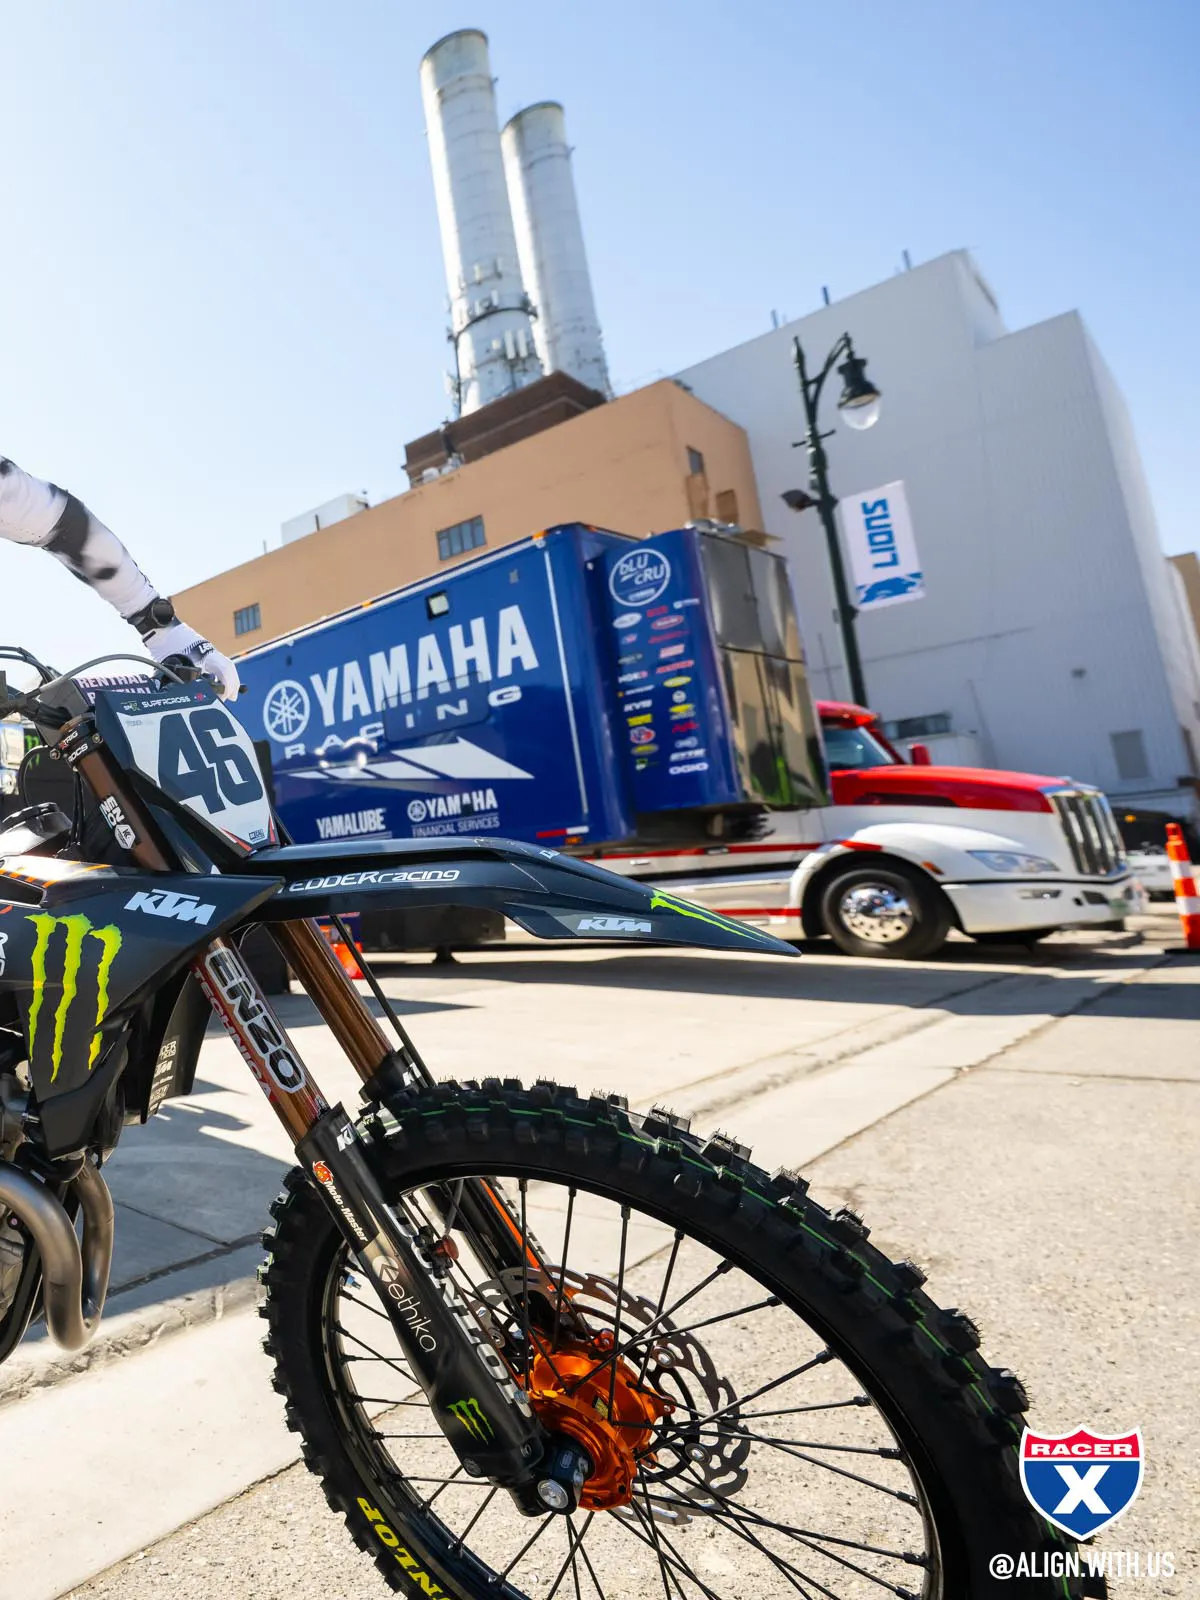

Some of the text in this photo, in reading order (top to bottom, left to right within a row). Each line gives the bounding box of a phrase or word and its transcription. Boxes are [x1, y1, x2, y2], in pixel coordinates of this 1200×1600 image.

[861, 498, 899, 568] LIONS
[78, 674, 148, 689] RENTHAL
[310, 604, 539, 728] YAMAHA
[158, 708, 263, 814] 46
[316, 808, 385, 839] YAMALUBE
[412, 815, 500, 838] FINANCIAL SERVICES
[123, 888, 217, 926] KTM
[577, 917, 652, 933] KTM
[205, 946, 306, 1094] ENZO
[357, 1497, 451, 1600] NLOP
